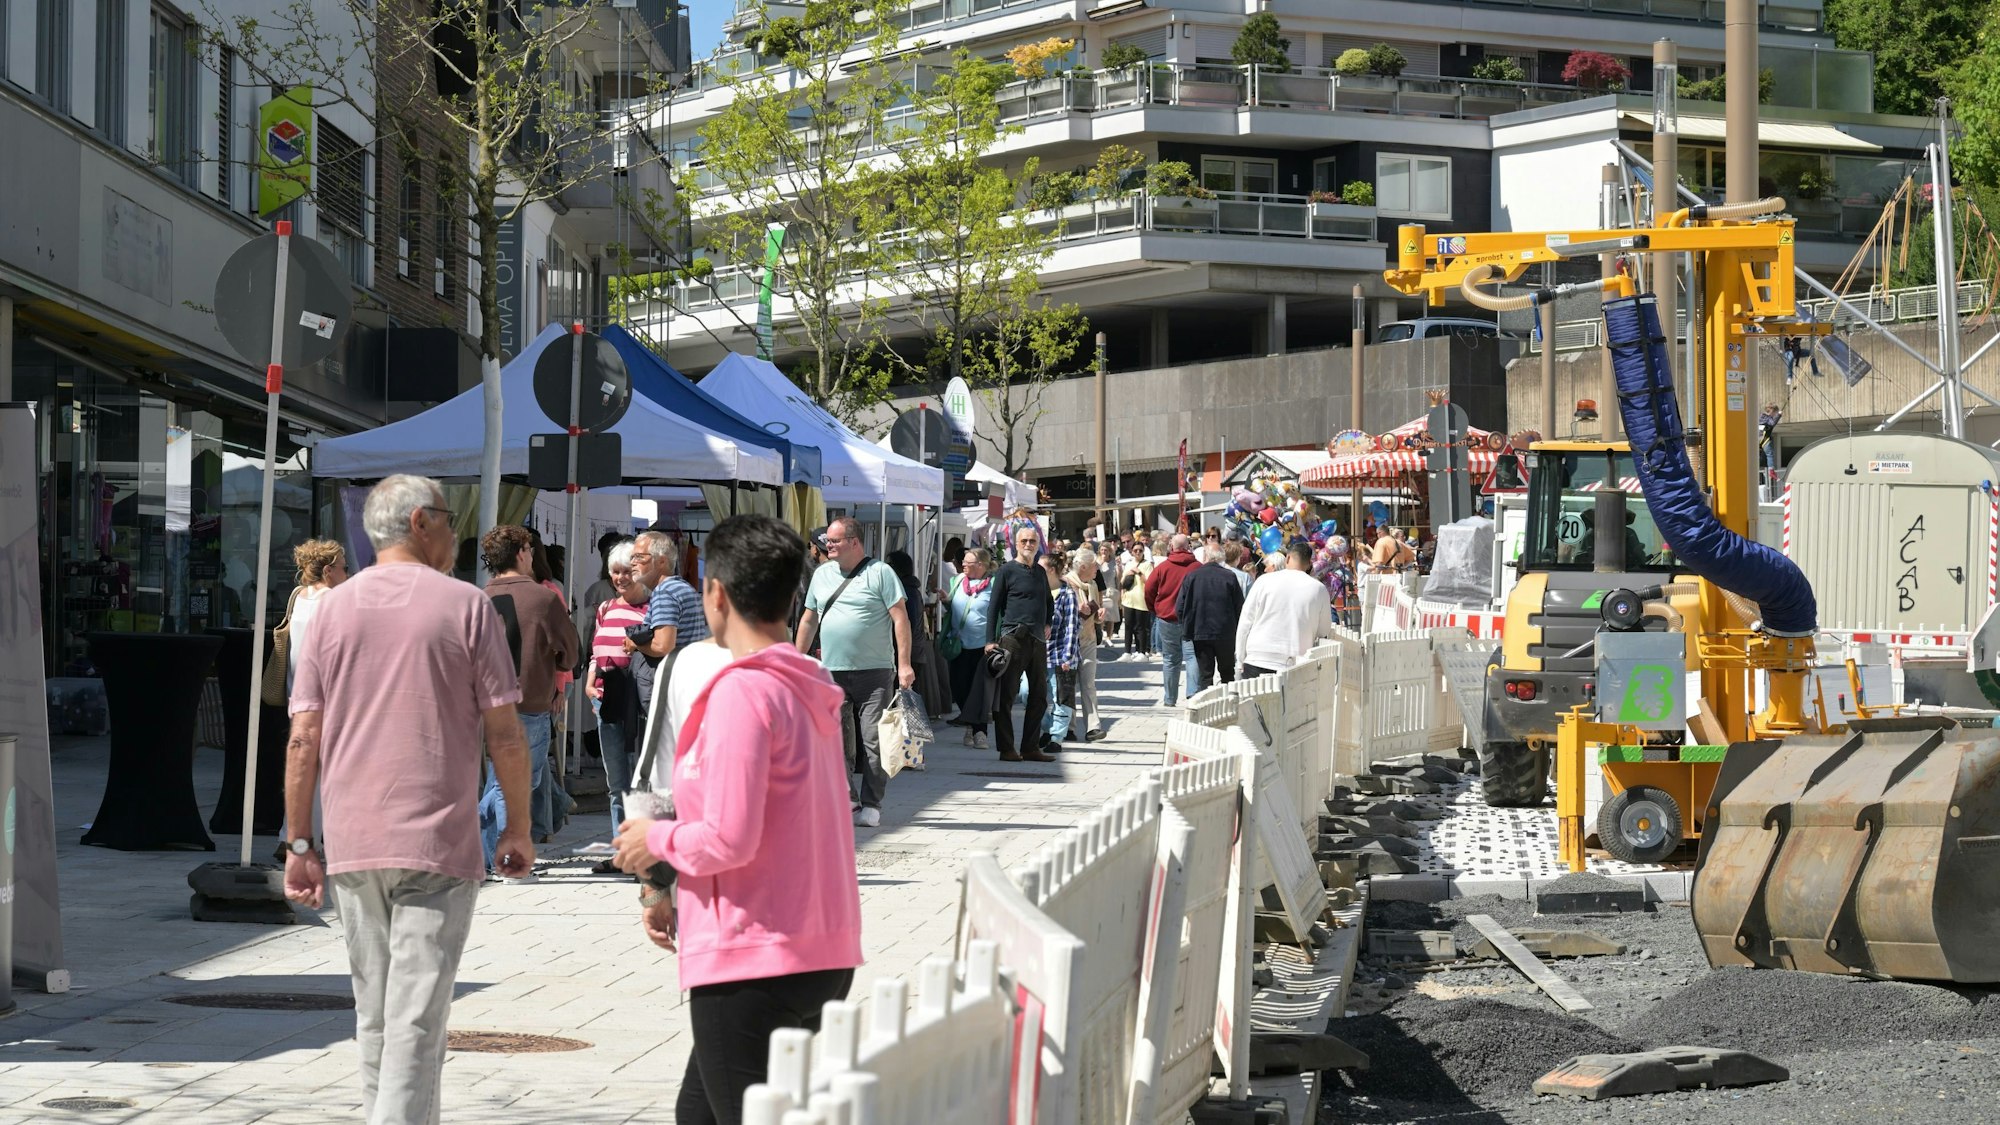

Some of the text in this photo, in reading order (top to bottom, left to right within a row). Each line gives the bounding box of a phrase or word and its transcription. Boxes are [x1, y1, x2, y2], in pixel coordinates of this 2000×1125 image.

[1480, 253, 1504, 264] probst
[1561, 520, 1579, 539] 20
[1896, 514, 1926, 613] ACAB
